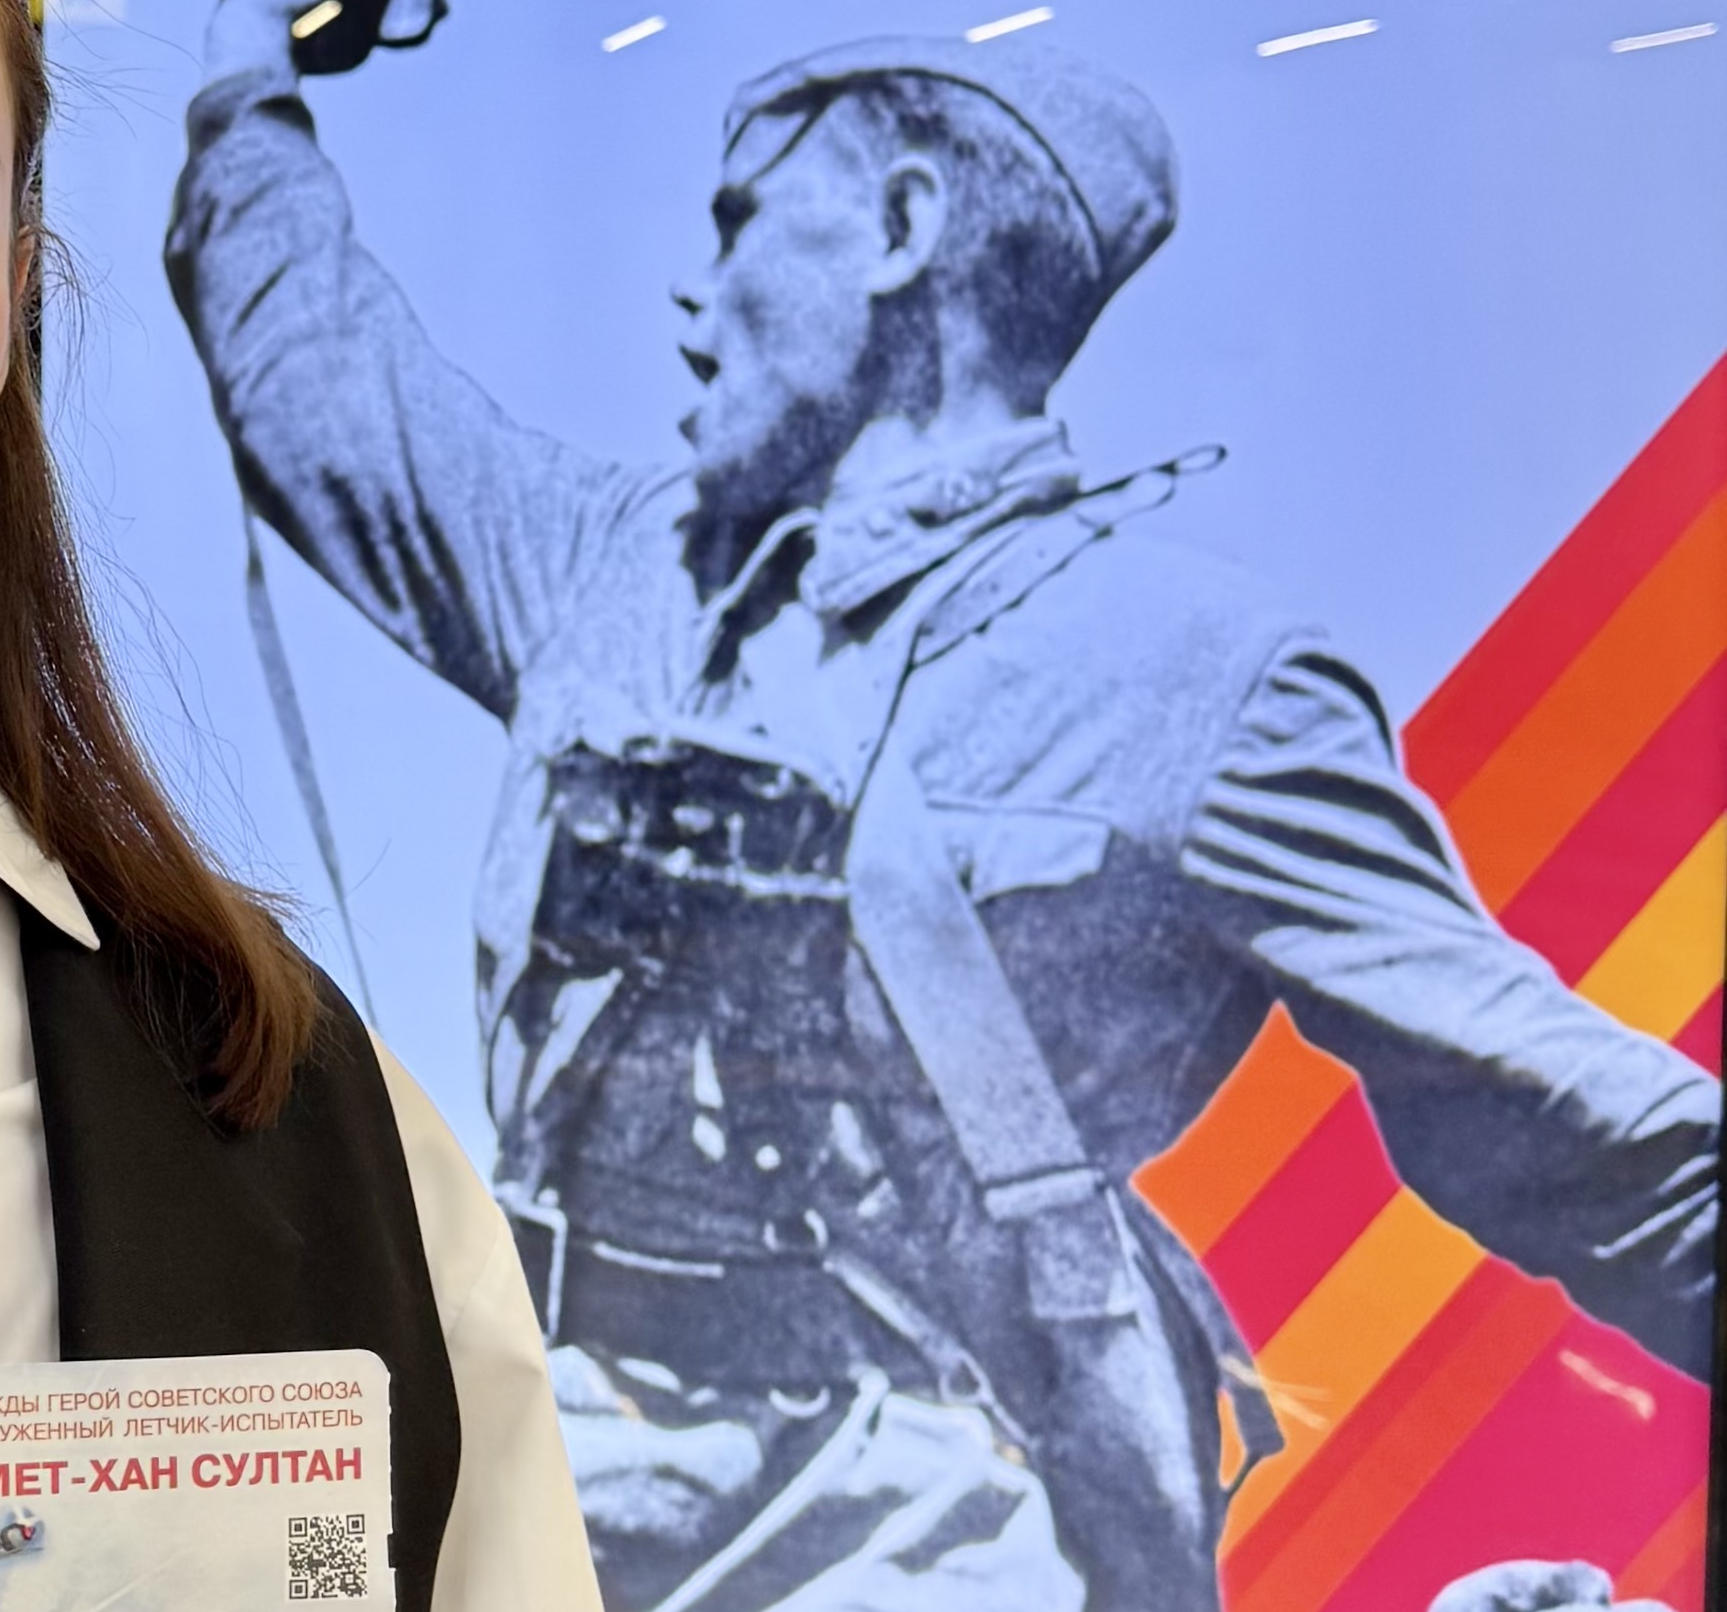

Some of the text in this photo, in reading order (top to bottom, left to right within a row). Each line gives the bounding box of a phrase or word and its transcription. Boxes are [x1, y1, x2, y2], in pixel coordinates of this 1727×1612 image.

[47, 1388, 121, 1413] ГЕРОЙ
[127, 1384, 275, 1410] СОВЕТСКОГО
[281, 1380, 363, 1402] СОЮЗА
[123, 1408, 364, 1438] ЛЕТЧИК-ИСПЫТАТЕЛЬ
[191, 1447, 362, 1489] СУЛТАН
